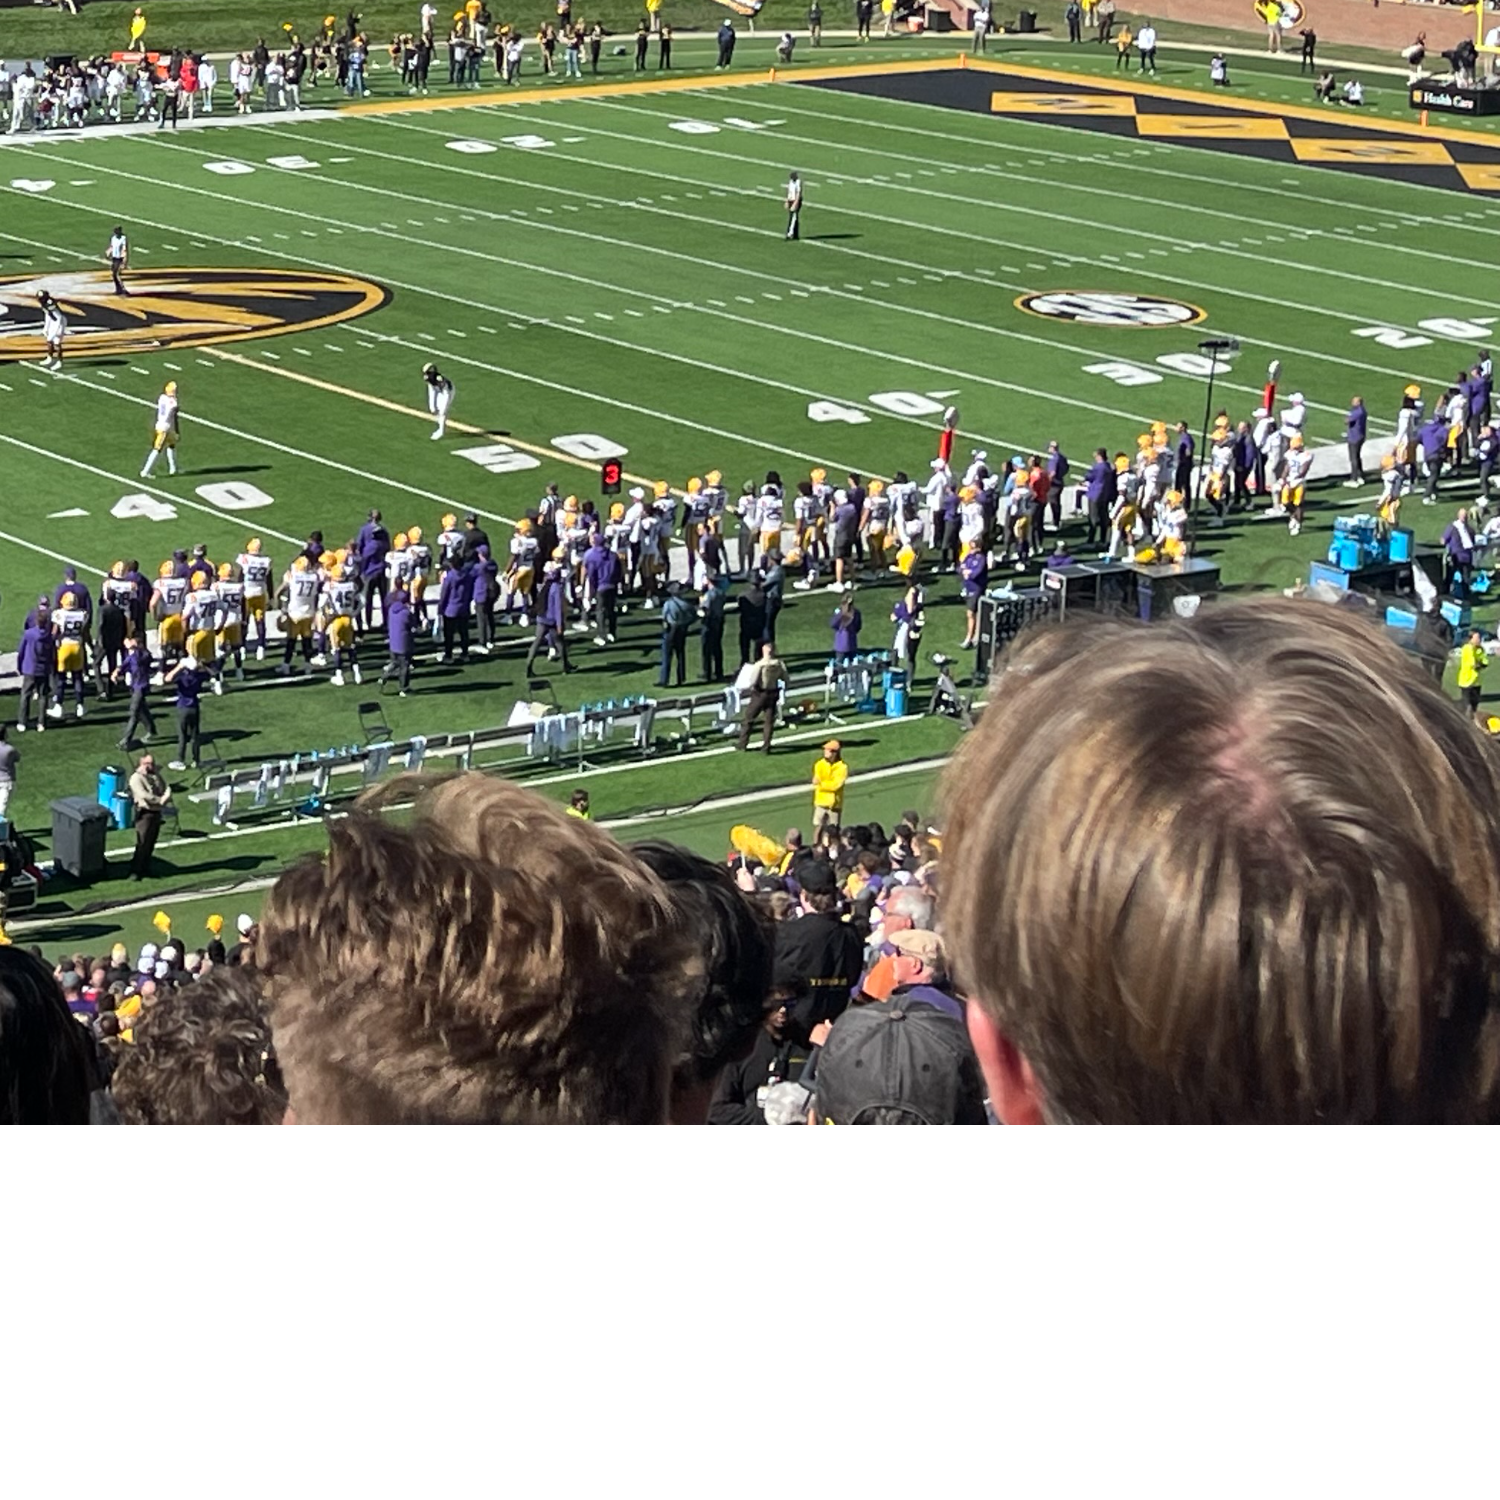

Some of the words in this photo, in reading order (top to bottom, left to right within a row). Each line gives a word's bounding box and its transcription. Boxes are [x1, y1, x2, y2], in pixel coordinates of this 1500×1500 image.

[1424, 91, 1452, 106] Health
[1453, 95, 1474, 109] Care
[1350, 317, 1494, 349] 20
[1082, 352, 1232, 386] 30
[807, 391, 946, 425] 40
[451, 433, 629, 473] 50
[605, 463, 619, 485] 3
[110, 481, 275, 522] 40
